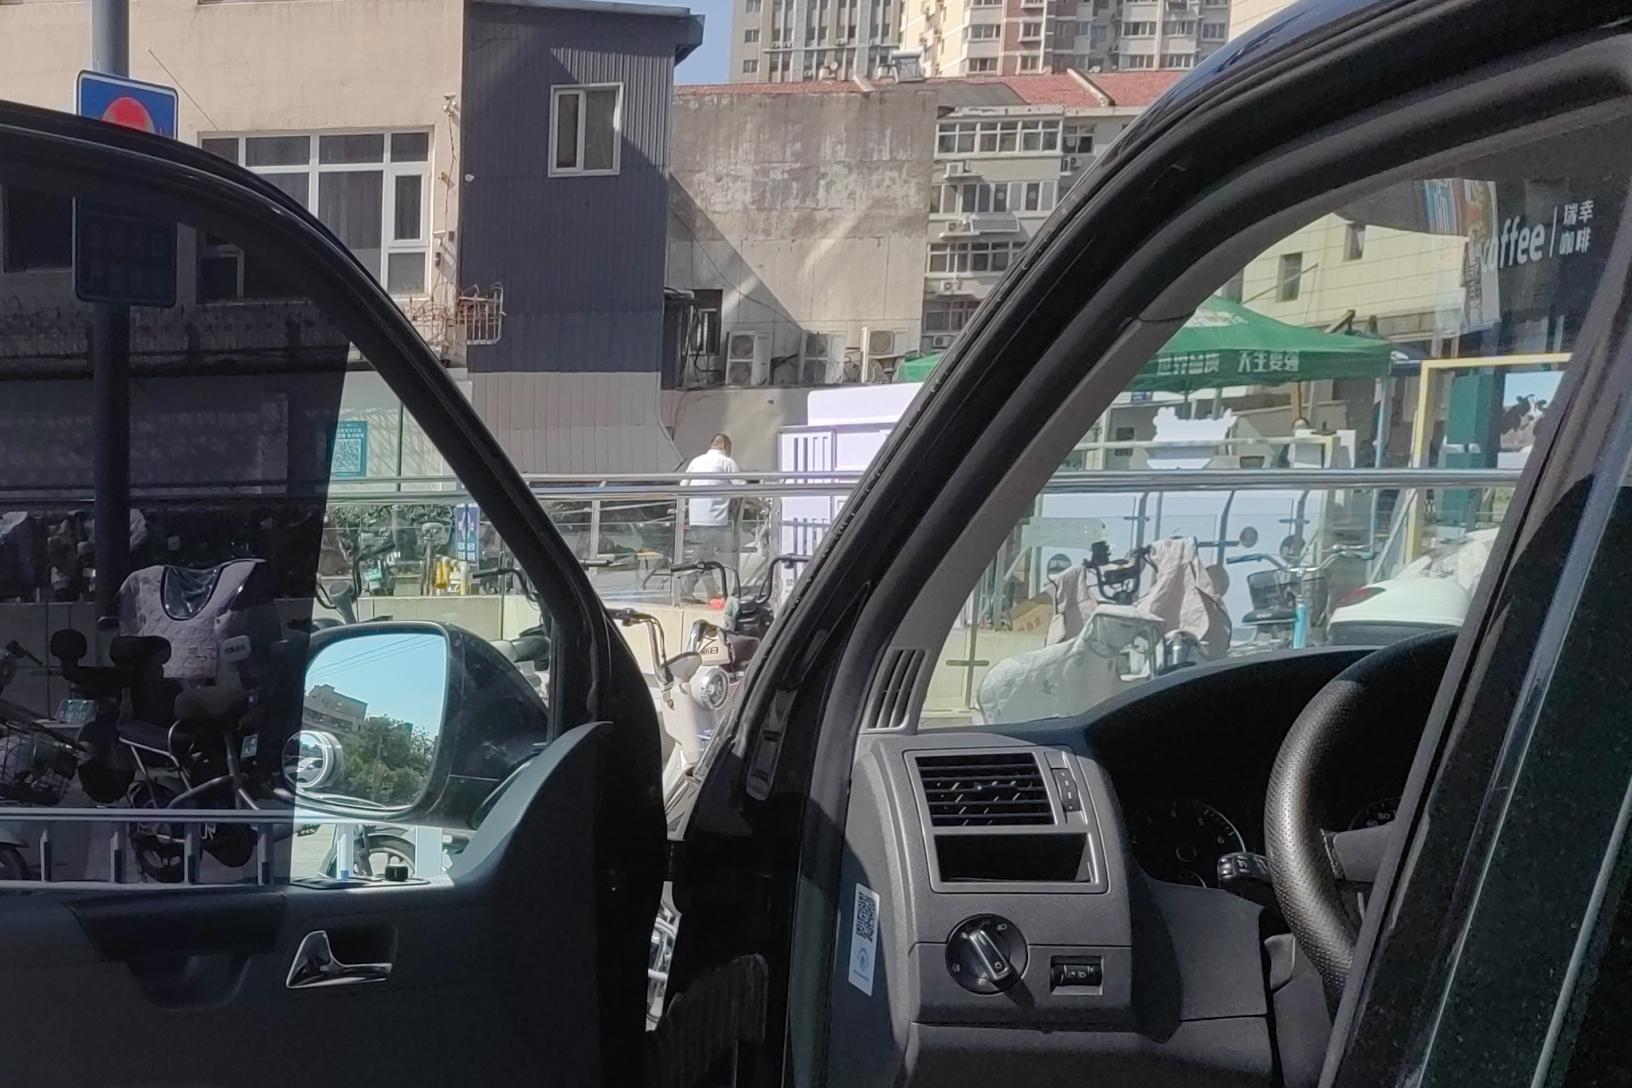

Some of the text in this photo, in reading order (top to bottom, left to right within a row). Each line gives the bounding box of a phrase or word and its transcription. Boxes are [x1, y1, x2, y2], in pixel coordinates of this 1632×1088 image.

[1563, 199, 1595, 226] 瑞幸
[1480, 215, 1546, 275] coffee
[1559, 226, 1592, 255] 咖啡
